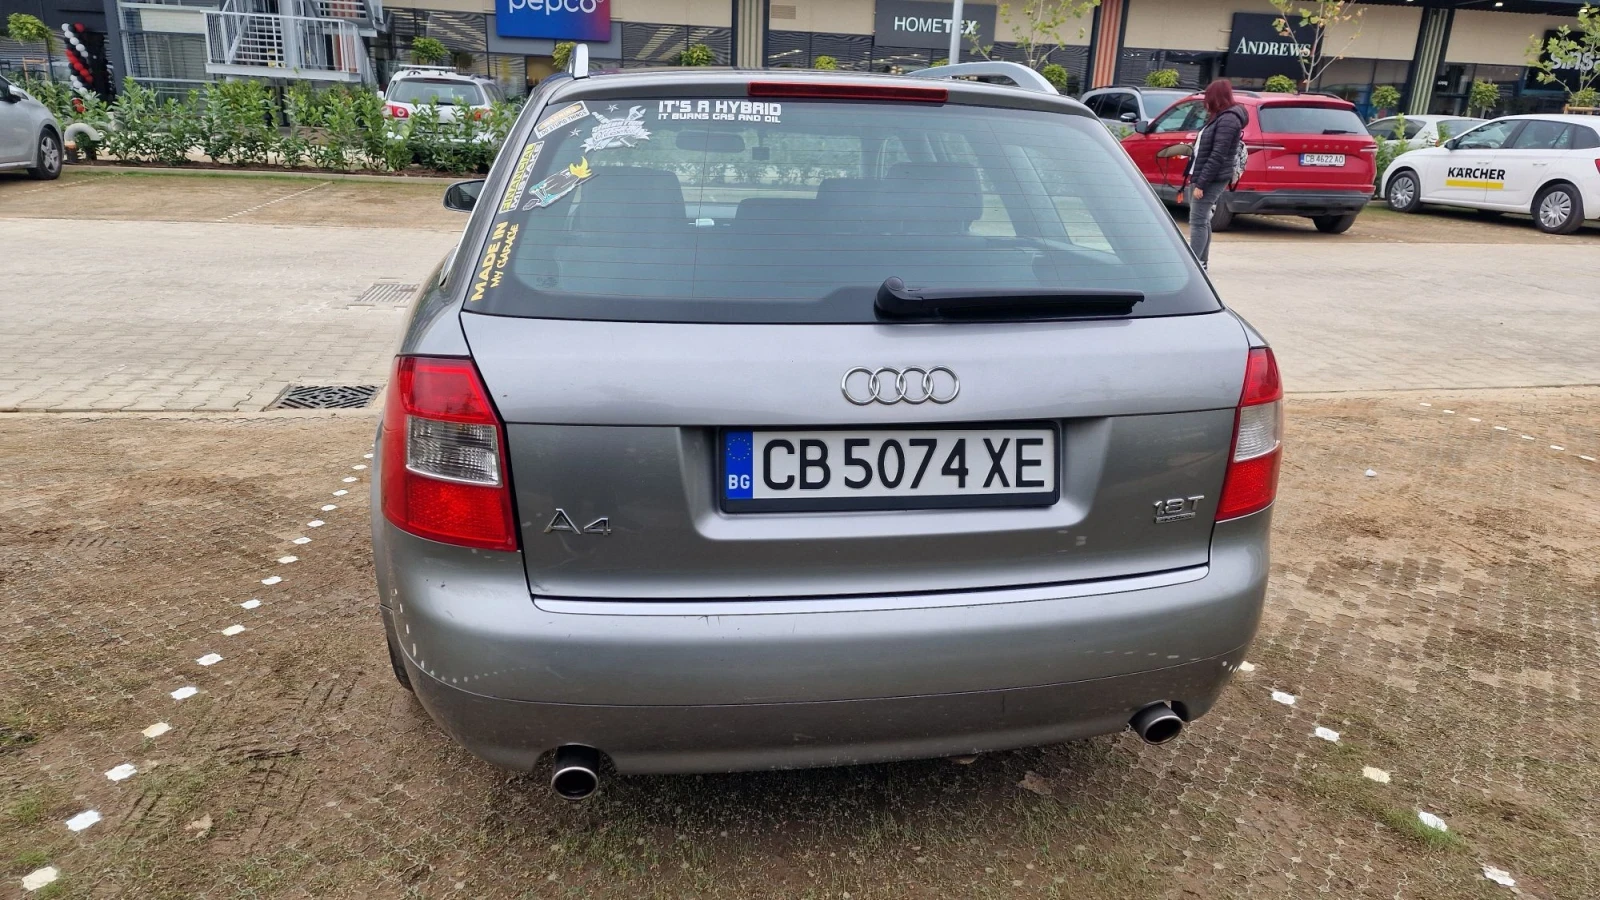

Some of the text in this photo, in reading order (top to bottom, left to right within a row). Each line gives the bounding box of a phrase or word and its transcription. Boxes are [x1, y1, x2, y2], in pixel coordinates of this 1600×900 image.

[509, 0, 597, 15] pepco
[658, 100, 782, 116] IT'S A HYBRID
[712, 113, 735, 121] GAS
[738, 114, 761, 122] AND
[1316, 155, 1334, 164] 4622
[502, 143, 535, 211] FINANCIAL
[511, 144, 543, 208] MISTAKE
[1447, 167, 1506, 180] KÄRCHER
[471, 221, 508, 301] MADE IN
[728, 438, 1045, 490] BG CB 5074 XE
[543, 508, 612, 536] A4
